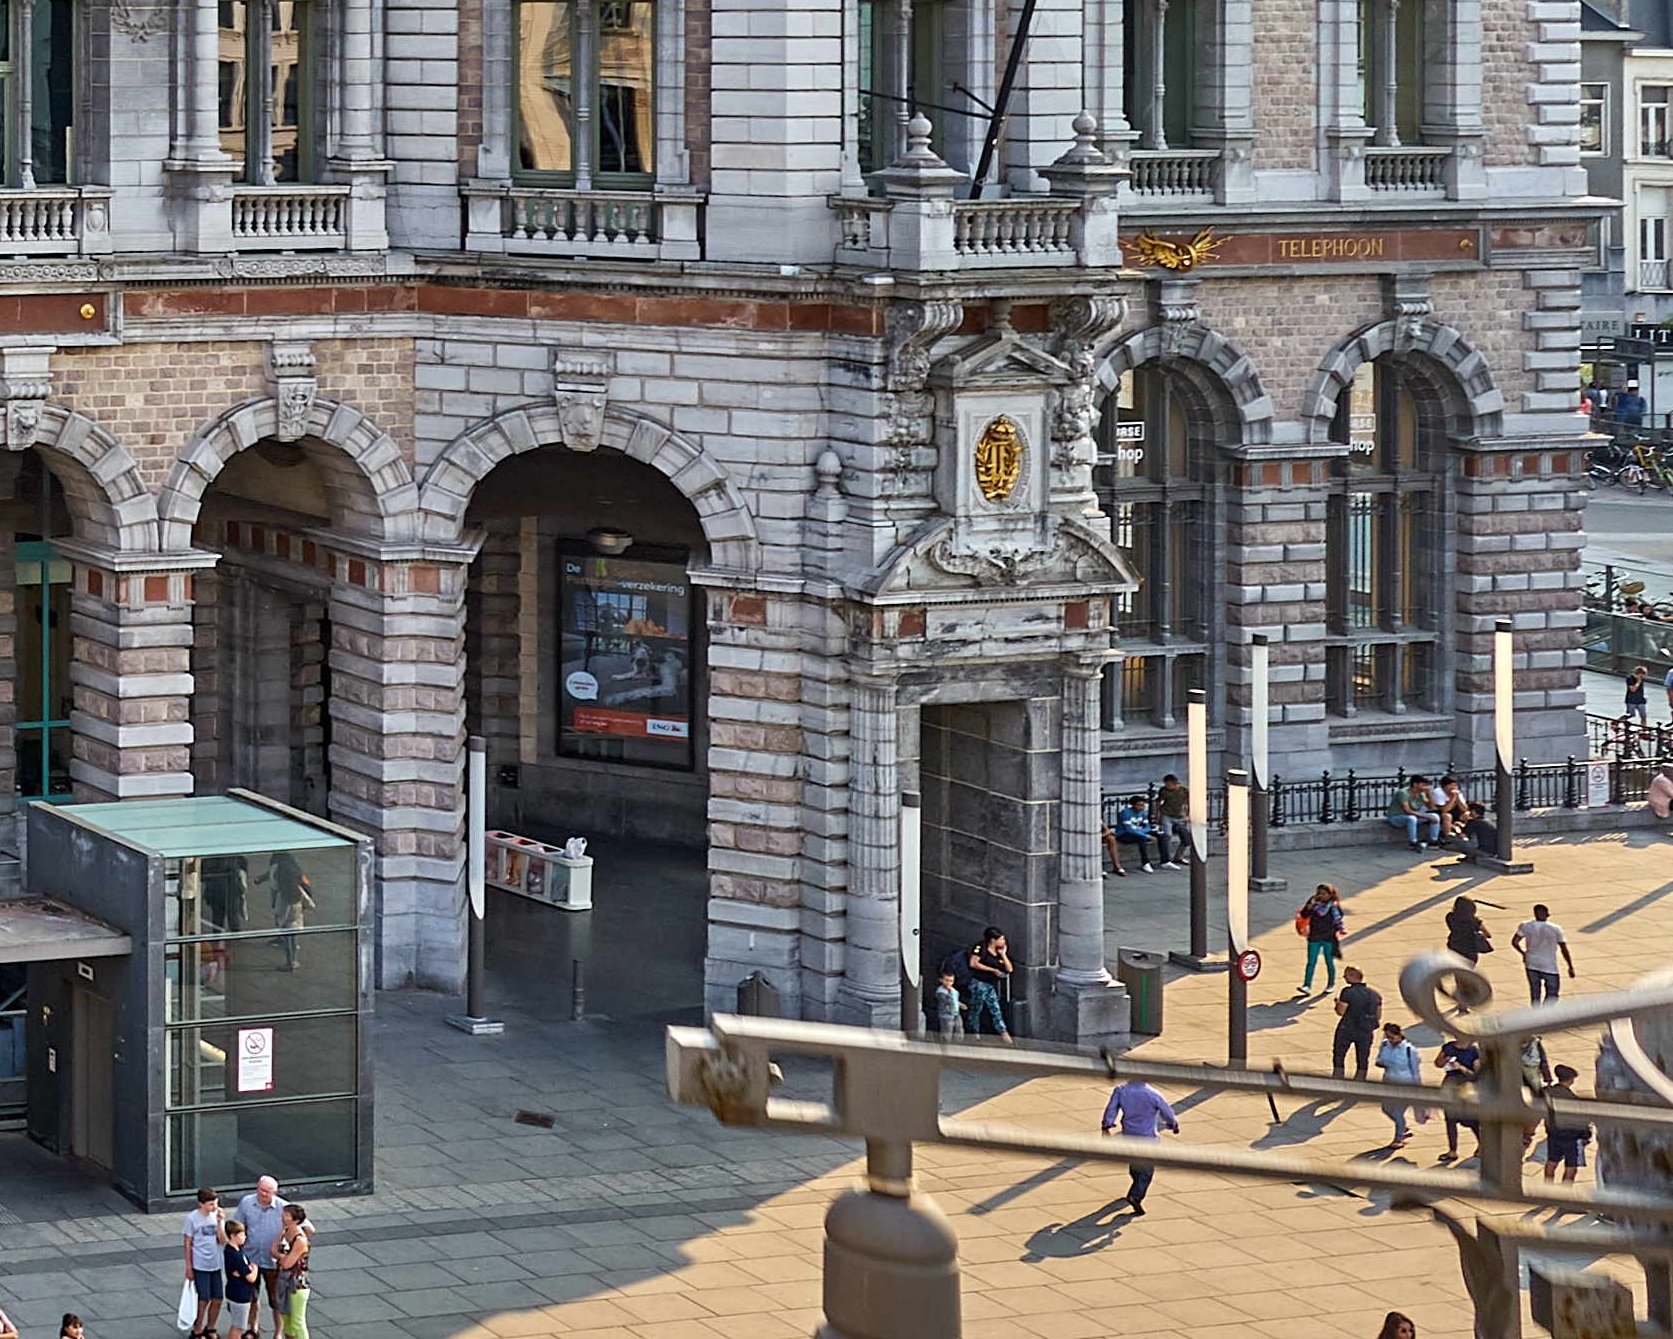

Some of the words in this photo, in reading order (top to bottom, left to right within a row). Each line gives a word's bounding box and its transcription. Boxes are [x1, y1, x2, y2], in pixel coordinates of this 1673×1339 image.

[1278, 238, 1383, 258] TELEPHOON
[1351, 418, 1372, 429] ASE
[1118, 444, 1143, 464] hop
[1350, 436, 1375, 455] hop
